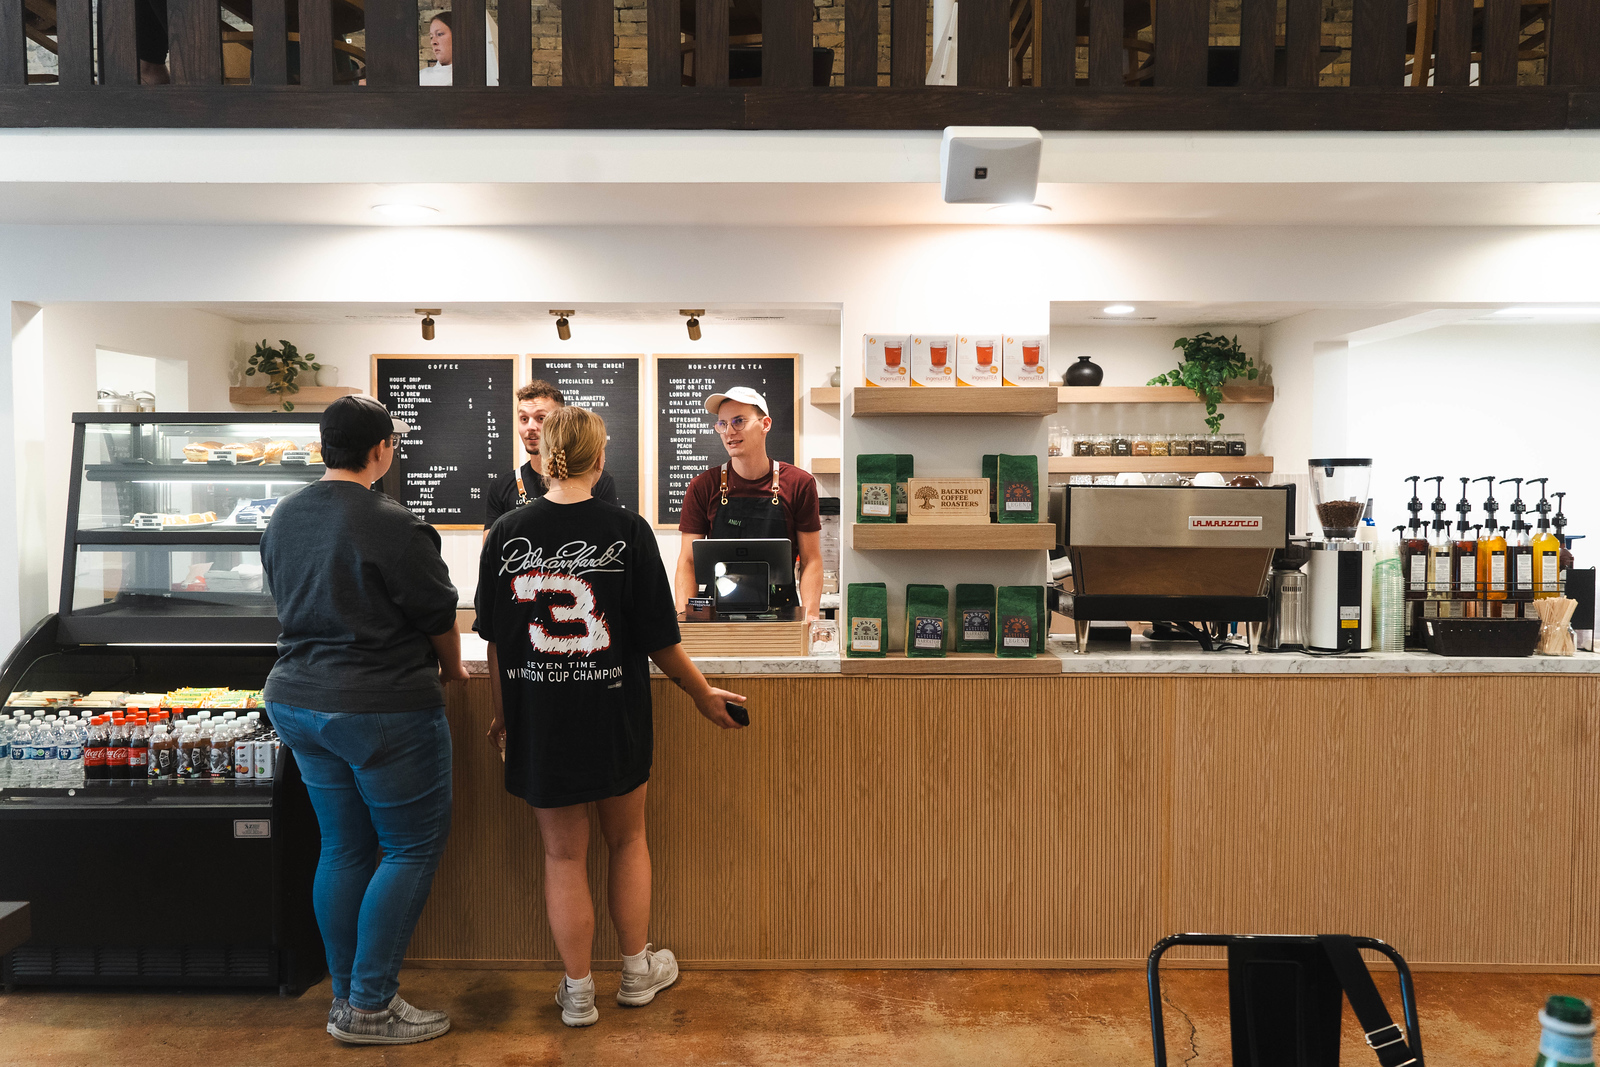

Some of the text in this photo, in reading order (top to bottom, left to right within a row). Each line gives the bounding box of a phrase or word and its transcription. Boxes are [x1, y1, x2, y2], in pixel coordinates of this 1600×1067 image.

[602, 362, 624, 370] EMBER!
[511, 568, 611, 655] 3
[526, 661, 597, 670] SEVEN TIME
[507, 665, 623, 682] WINSTON CUP CHAMPION
